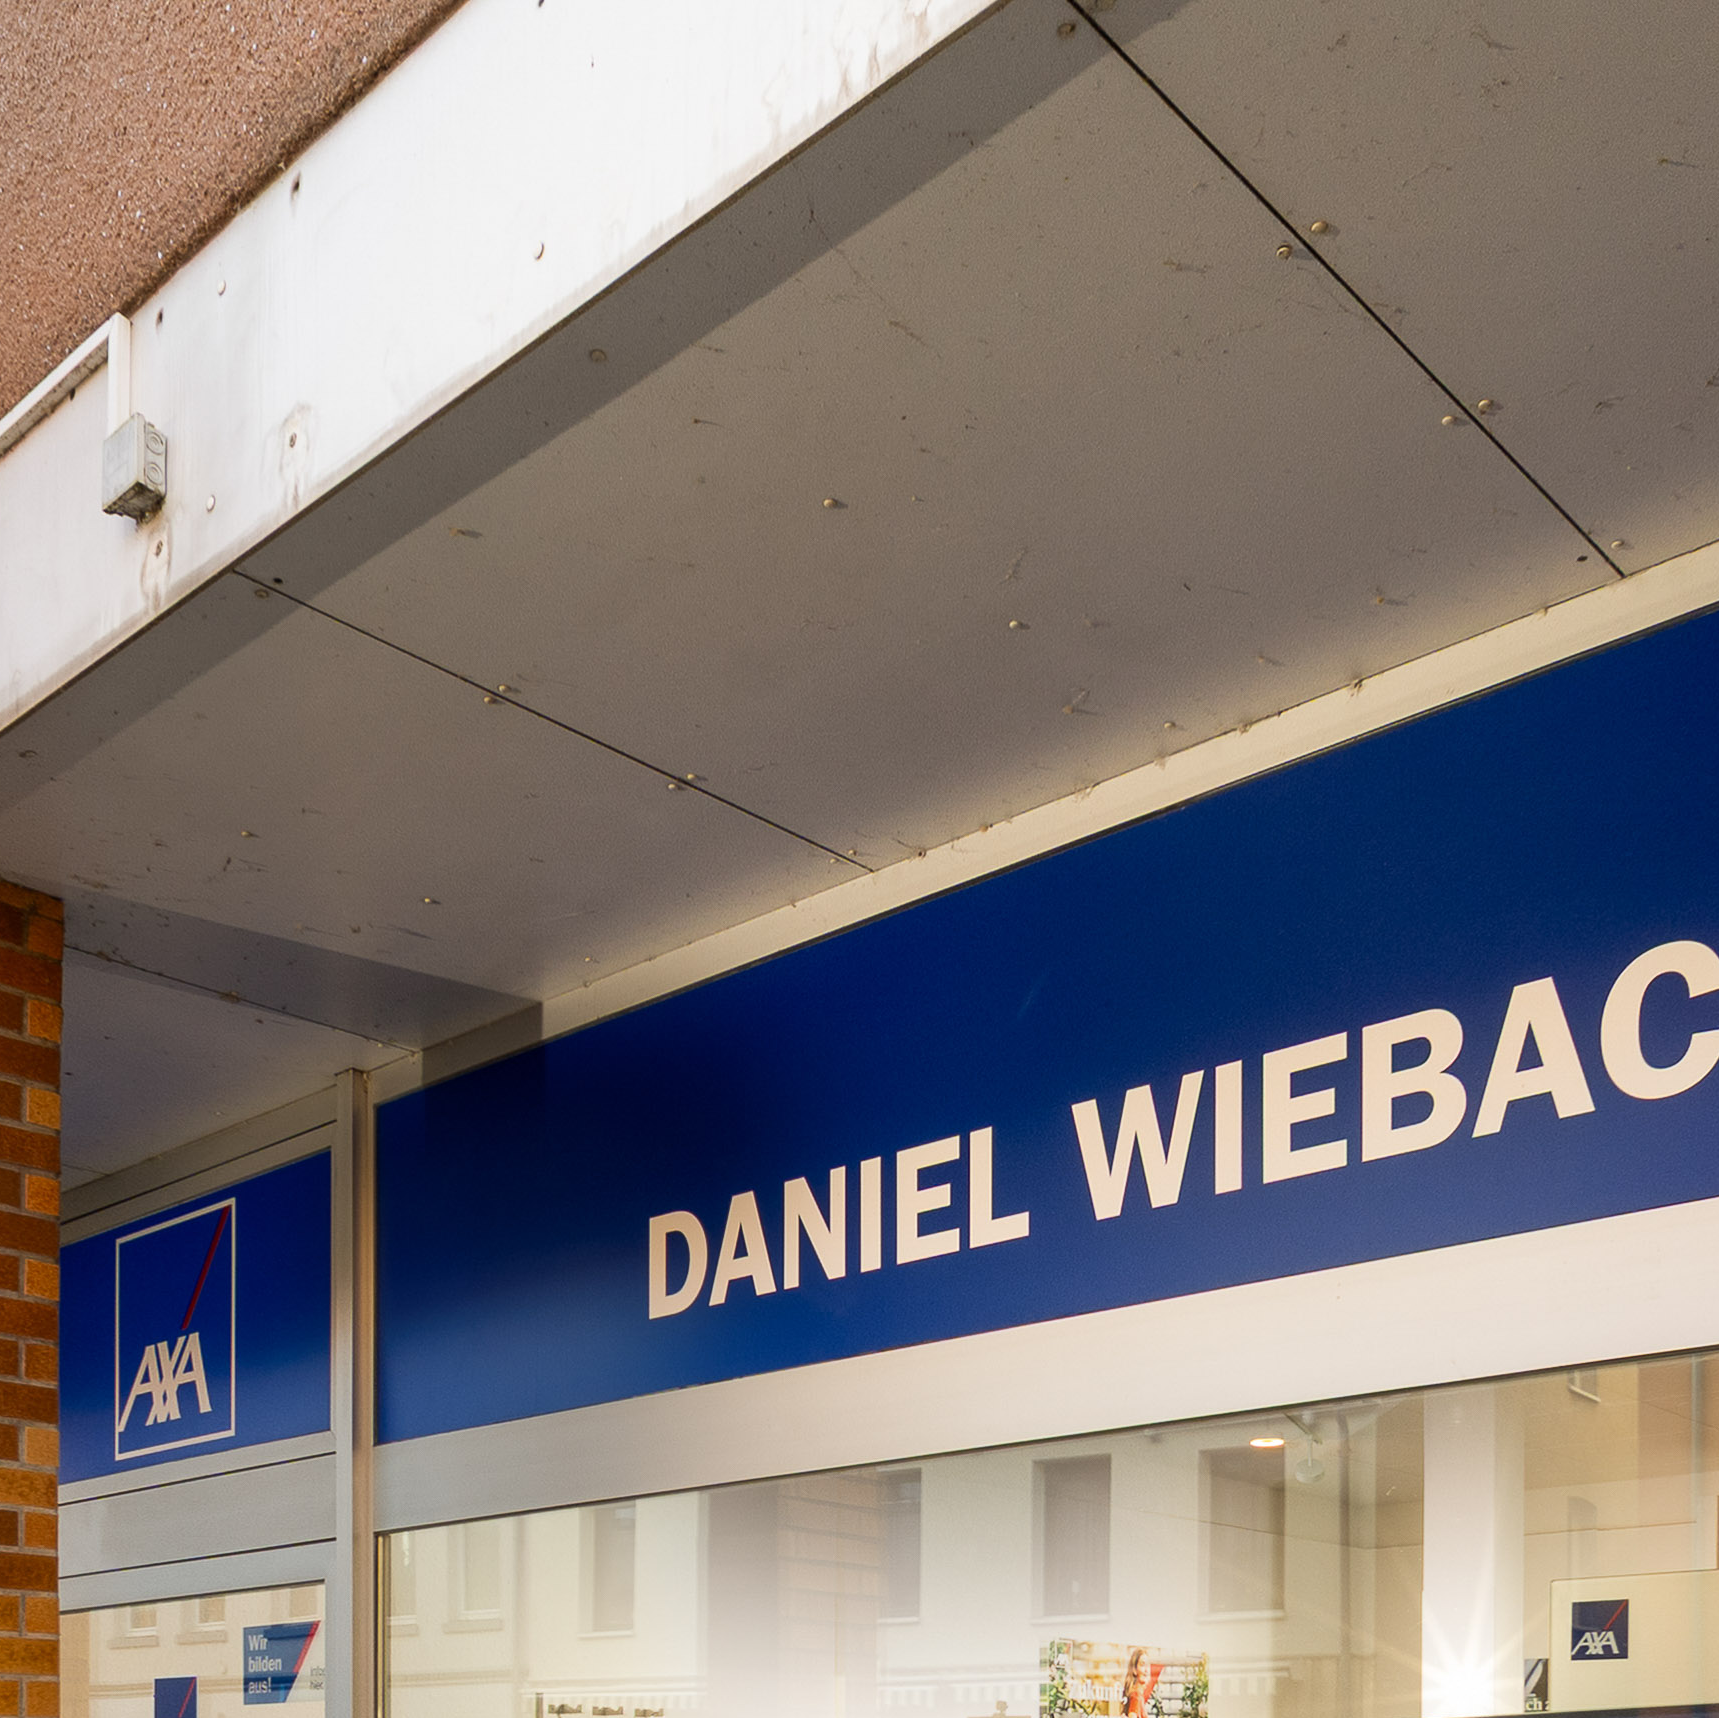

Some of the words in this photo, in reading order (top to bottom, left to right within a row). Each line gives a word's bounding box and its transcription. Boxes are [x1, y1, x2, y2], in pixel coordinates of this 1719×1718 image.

[648, 1126, 1030, 1320] DANIEL
[117, 1331, 213, 1433] AXA
[248, 1634, 269, 1651] Wir
[1571, 1630, 1620, 1656] AXA
[248, 1656, 282, 1673] bilden
[248, 1676, 272, 1695] aus!
